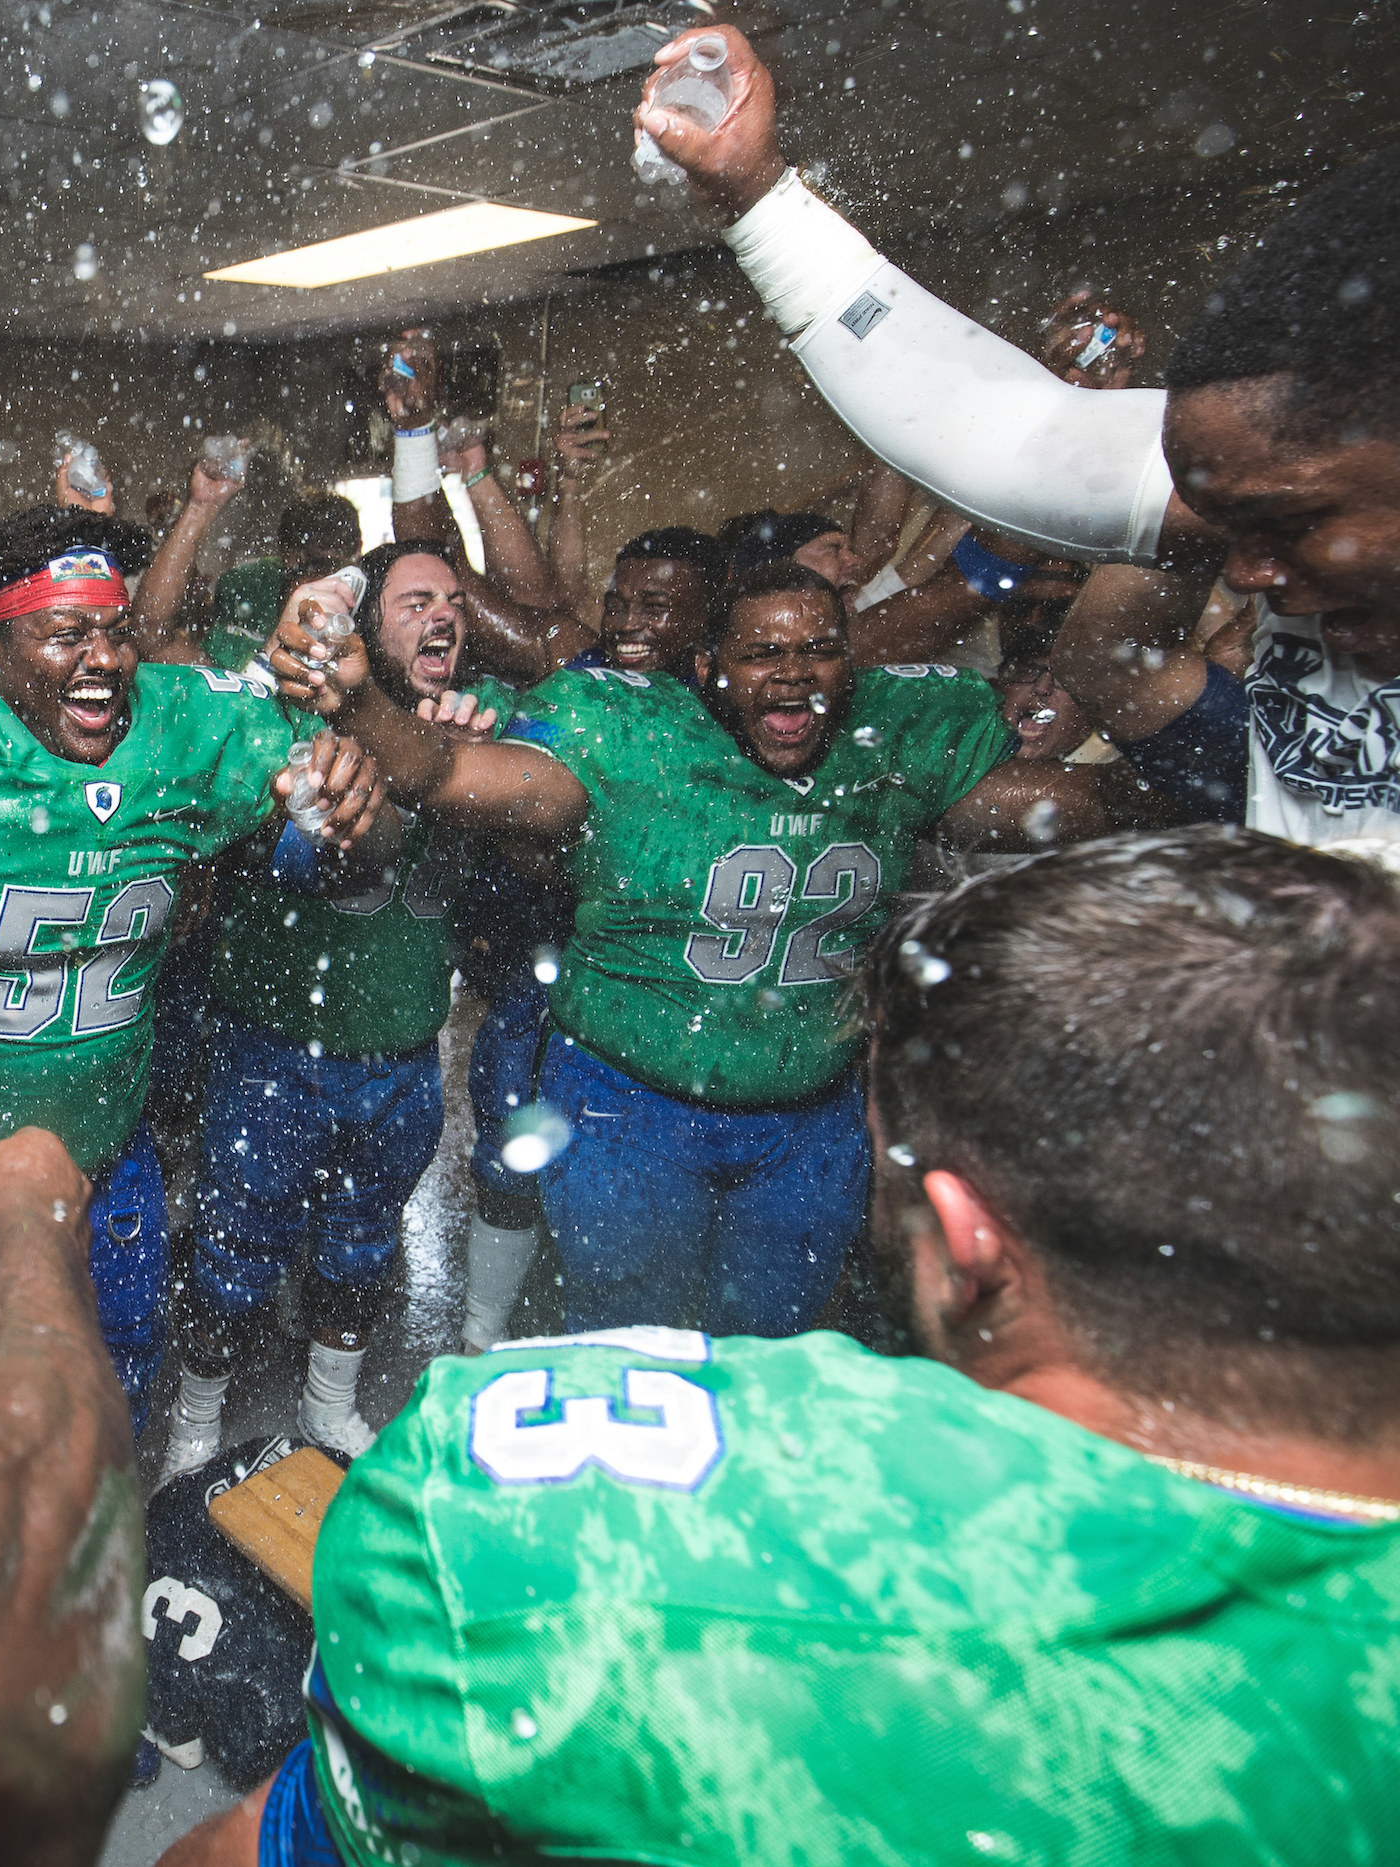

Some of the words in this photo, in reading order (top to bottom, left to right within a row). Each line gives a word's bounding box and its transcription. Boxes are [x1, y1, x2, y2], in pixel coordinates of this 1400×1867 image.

[850, 313, 863, 328] PRO
[861, 301, 875, 317] NIKE
[770, 813, 824, 837] UWF
[67, 848, 123, 877] UWF
[683, 841, 881, 986] 92
[468, 1324, 727, 1495] 3
[141, 1575, 224, 1663] 3
